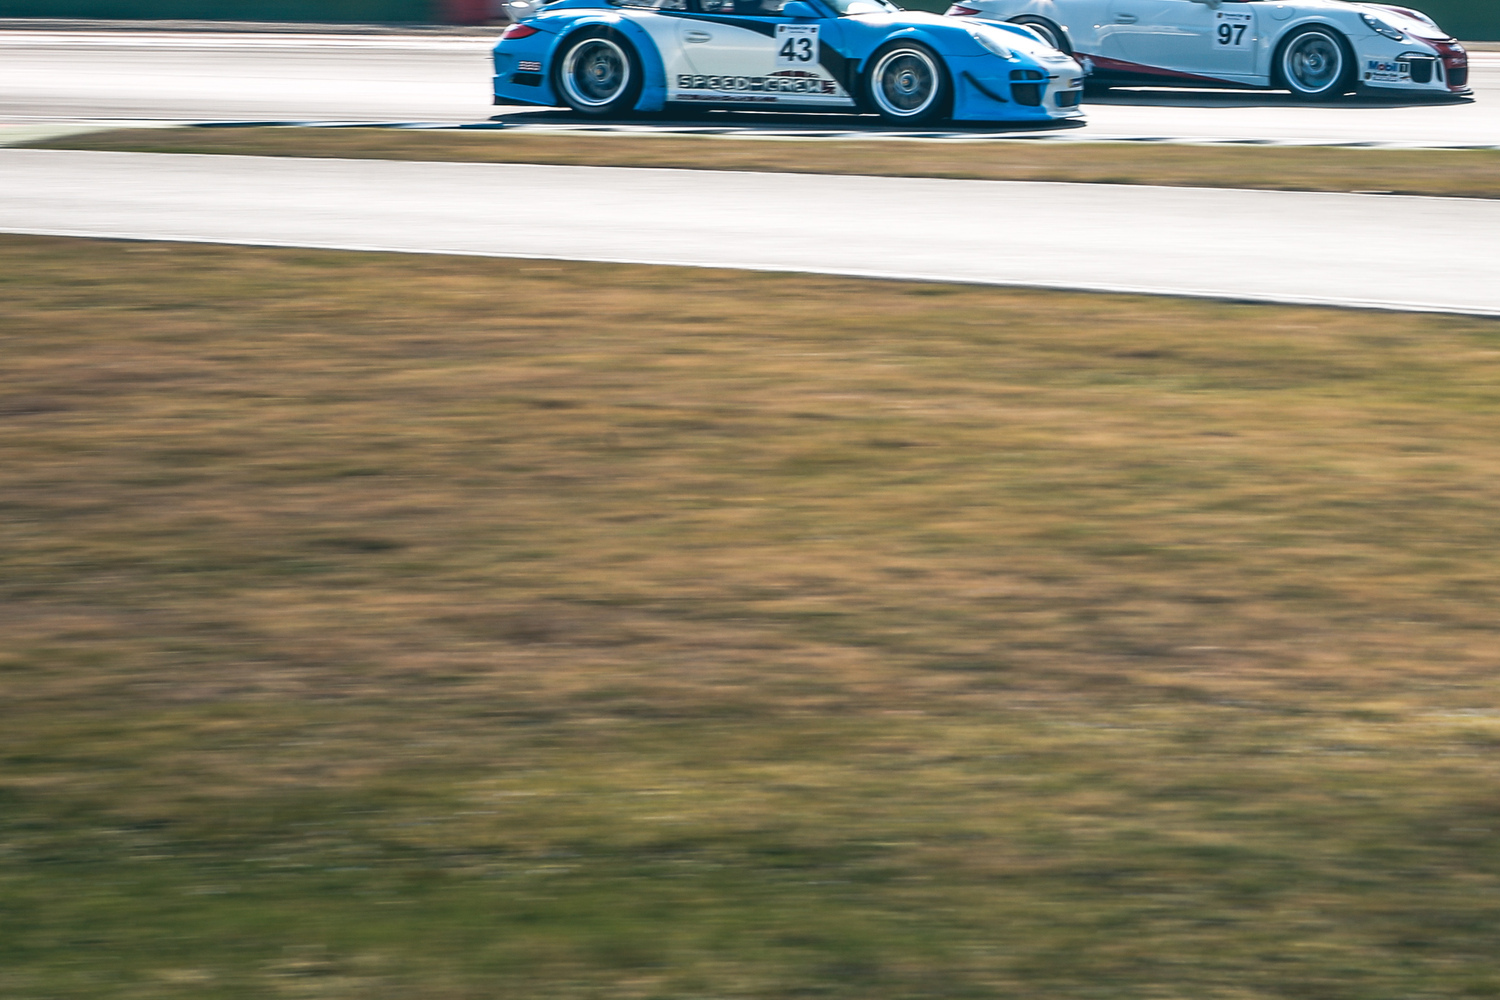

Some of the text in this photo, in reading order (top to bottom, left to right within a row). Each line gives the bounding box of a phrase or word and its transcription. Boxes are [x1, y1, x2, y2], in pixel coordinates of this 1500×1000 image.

[1217, 23, 1248, 46] 97
[778, 37, 813, 62] 43
[1368, 60, 1399, 72] Mobil
